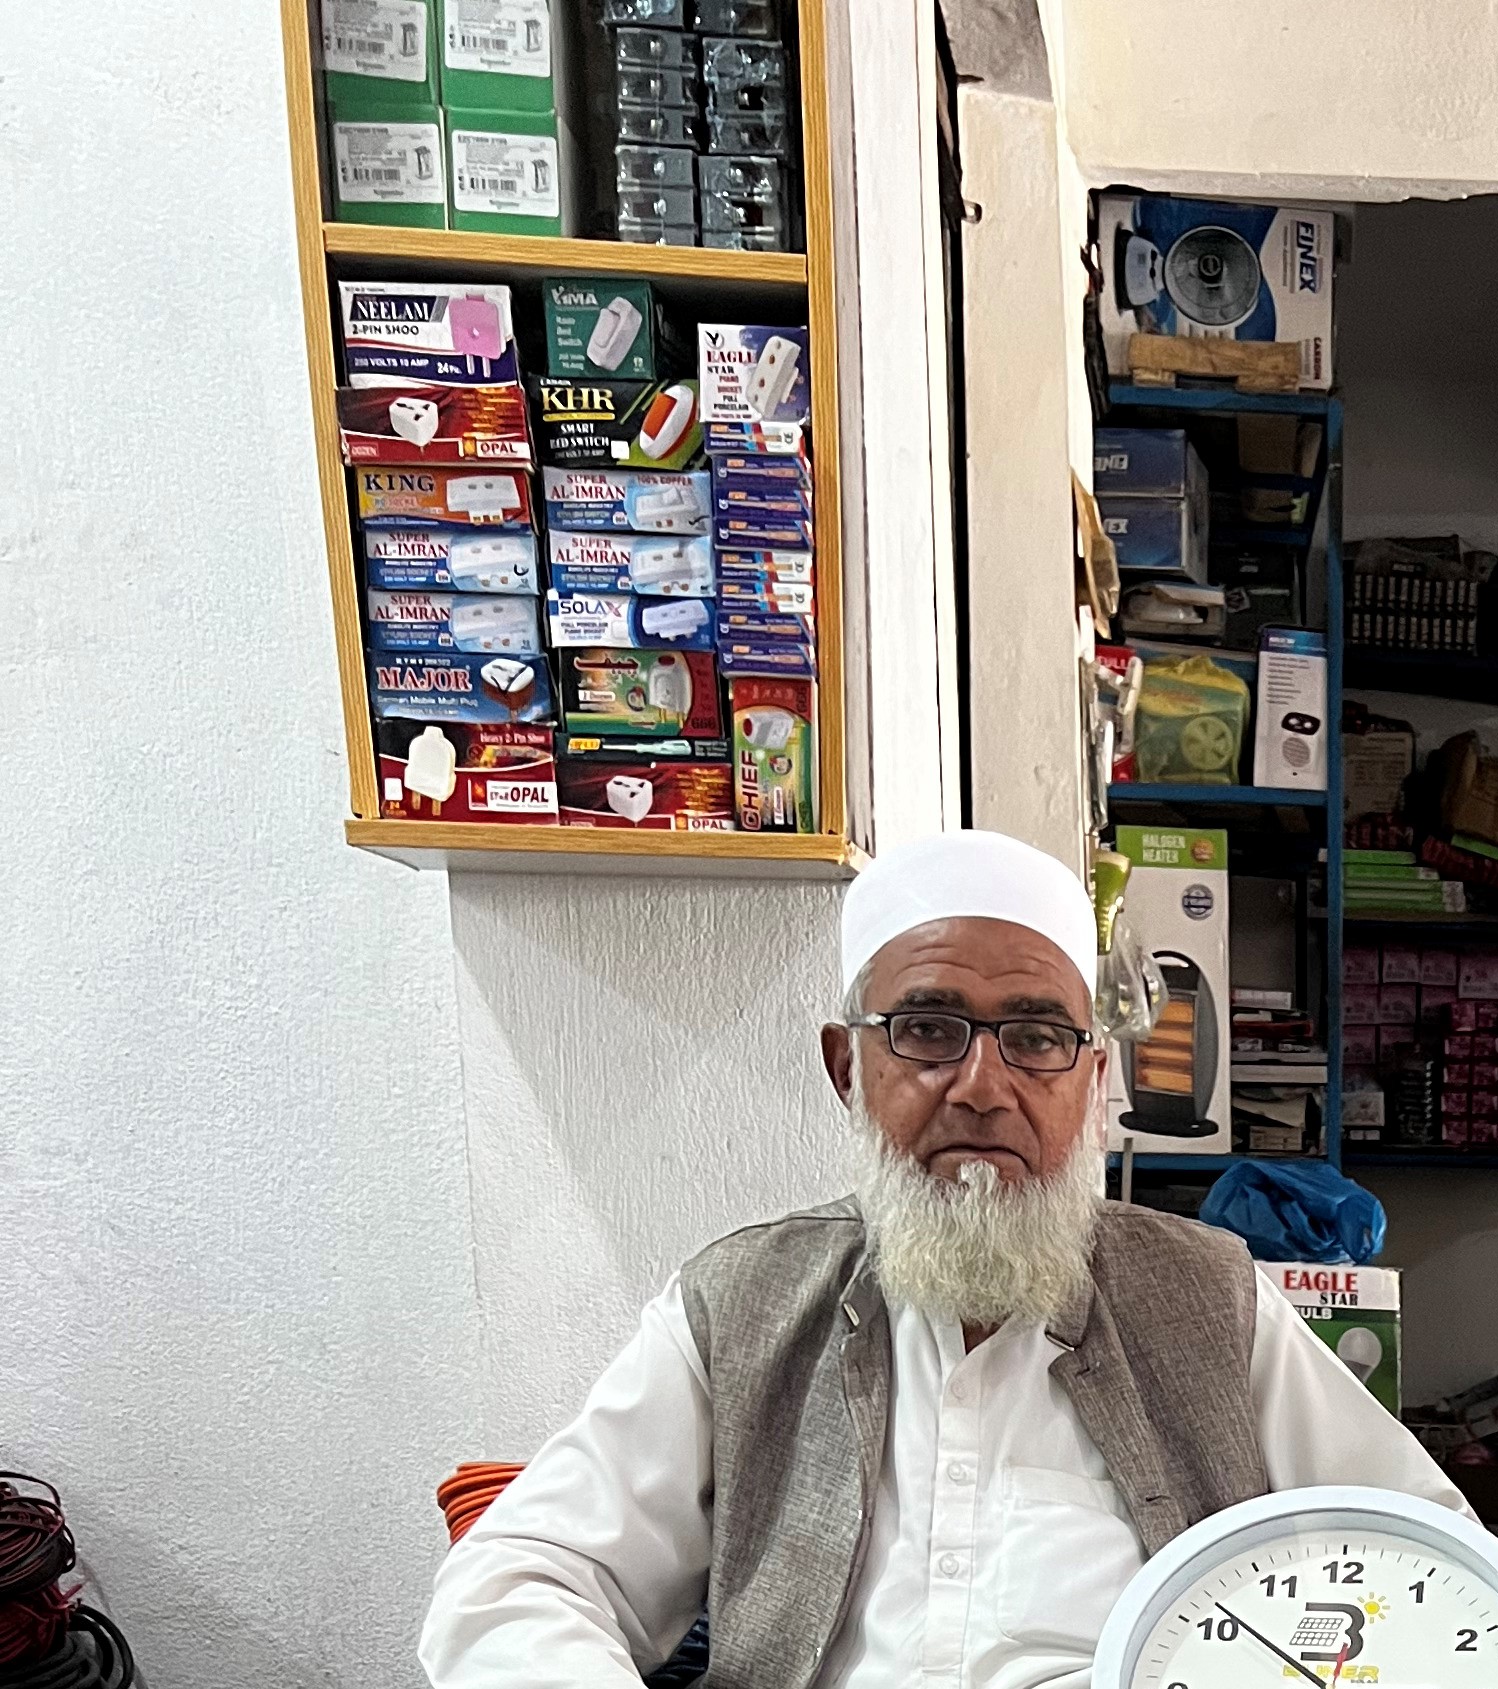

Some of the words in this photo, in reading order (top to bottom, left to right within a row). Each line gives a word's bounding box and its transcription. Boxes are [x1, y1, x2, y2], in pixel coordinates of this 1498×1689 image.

[1296, 220, 1318, 294] FINEX
[356, 300, 430, 321] NEELAM
[352, 323, 382, 335] 2-PIN
[385, 324, 420, 336] SHOO
[370, 357, 398, 367] VOLTS
[706, 350, 758, 365] EAGLE
[707, 366, 735, 374] STAR
[540, 387, 616, 411] KHR
[560, 423, 595, 434] SMART
[480, 442, 518, 455] OPAL
[570, 436, 610, 448] SWITCH
[364, 474, 435, 493] KING
[566, 474, 608, 485] SUPER
[550, 485, 626, 500] AL-IMRAN
[388, 532, 430, 543] SUPER
[571, 537, 612, 548] SUPER
[373, 543, 449, 558] AL-IMRAN
[555, 550, 631, 565] AL-IMRAN
[390, 594, 432, 605] SUPER
[374, 606, 450, 621] AL-IMRAN
[375, 666, 473, 692] MAJOR
[510, 786, 549, 803] OPAL
[741, 749, 761, 831] CHIEF
[691, 818, 728, 831] OPAL
[1284, 1268, 1359, 1293] EAGLE
[1319, 1292, 1359, 1307] STAR
[1295, 1307, 1333, 1320] ULB
[1323, 1561, 1364, 1584] 12
[1260, 1575, 1298, 1598] 11
[1409, 1581, 1426, 1603] 1
[1197, 1618, 1239, 1642] 10
[1455, 1629, 1478, 1652] 2
